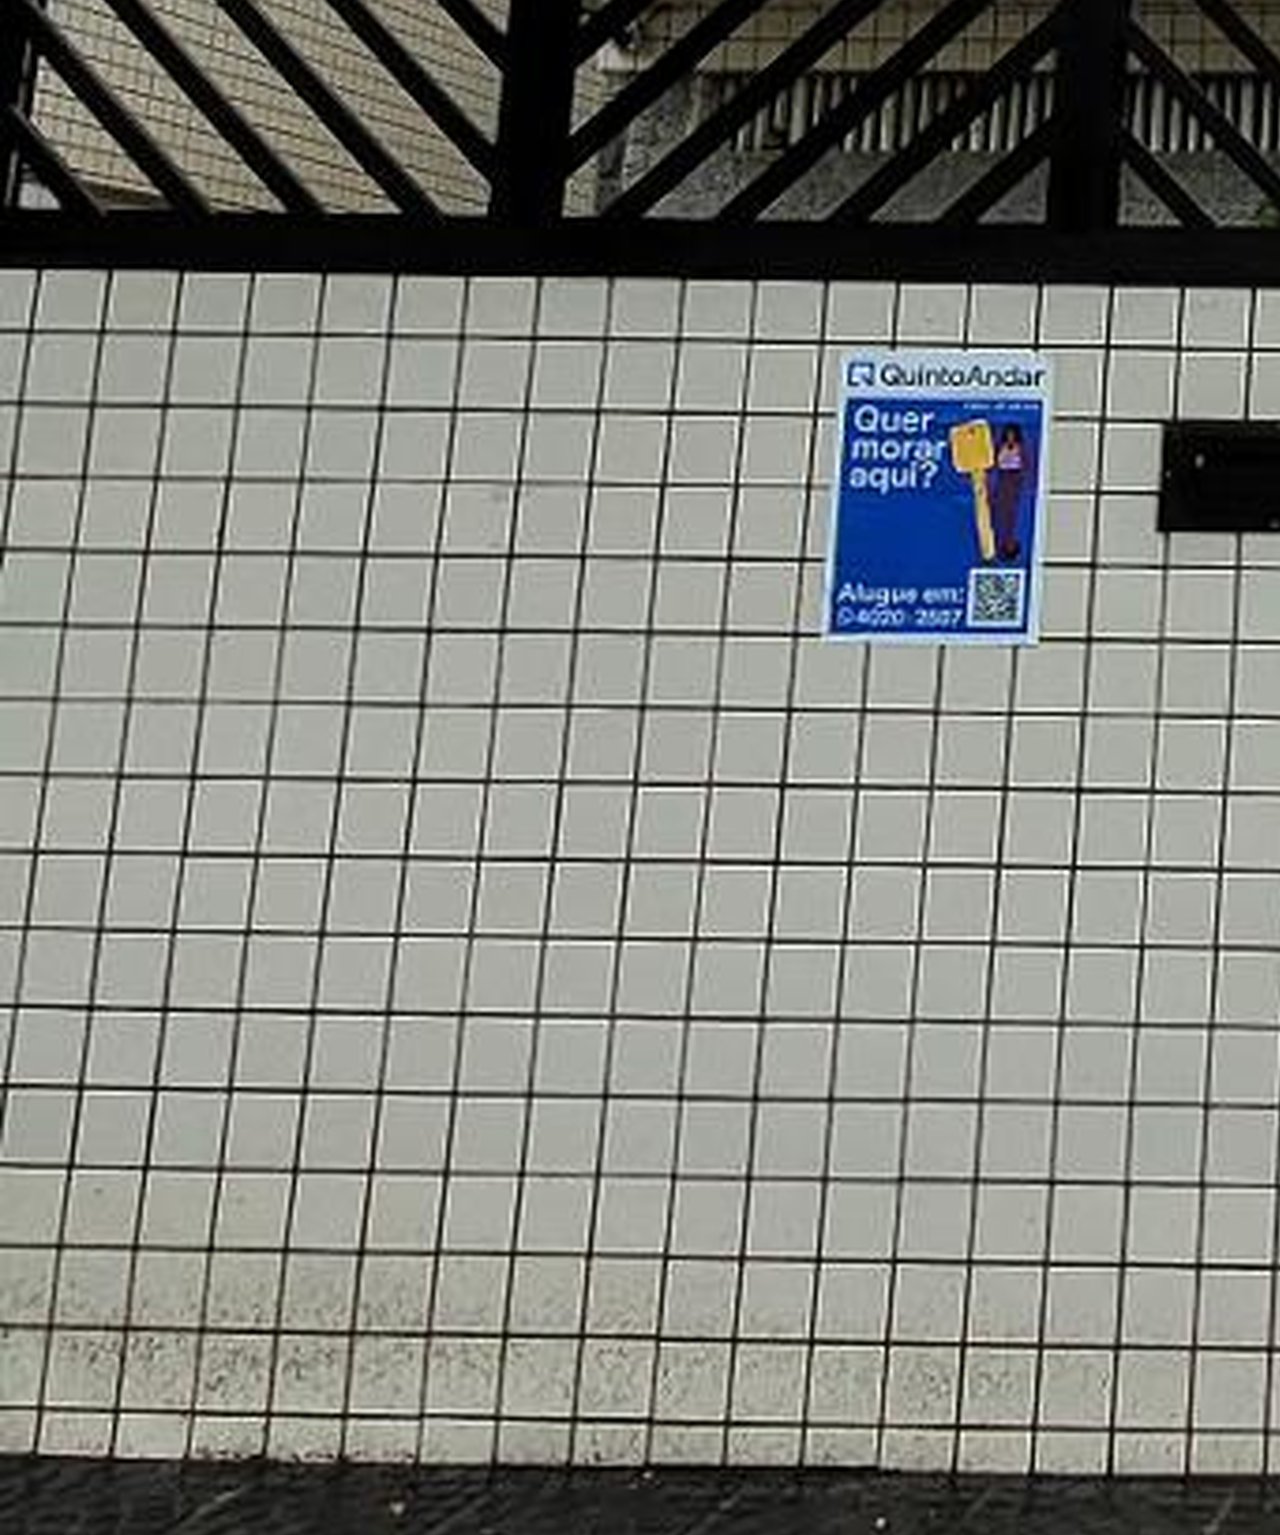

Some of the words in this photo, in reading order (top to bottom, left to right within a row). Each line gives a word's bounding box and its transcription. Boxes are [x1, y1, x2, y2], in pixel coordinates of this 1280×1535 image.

[880, 363, 1046, 388] QuintoAndar
[853, 403, 935, 433] Quer
[850, 437, 947, 461] morar
[849, 459, 939, 496] aqui?
[836, 582, 918, 608] Alugue
[922, 587, 965, 605] em:
